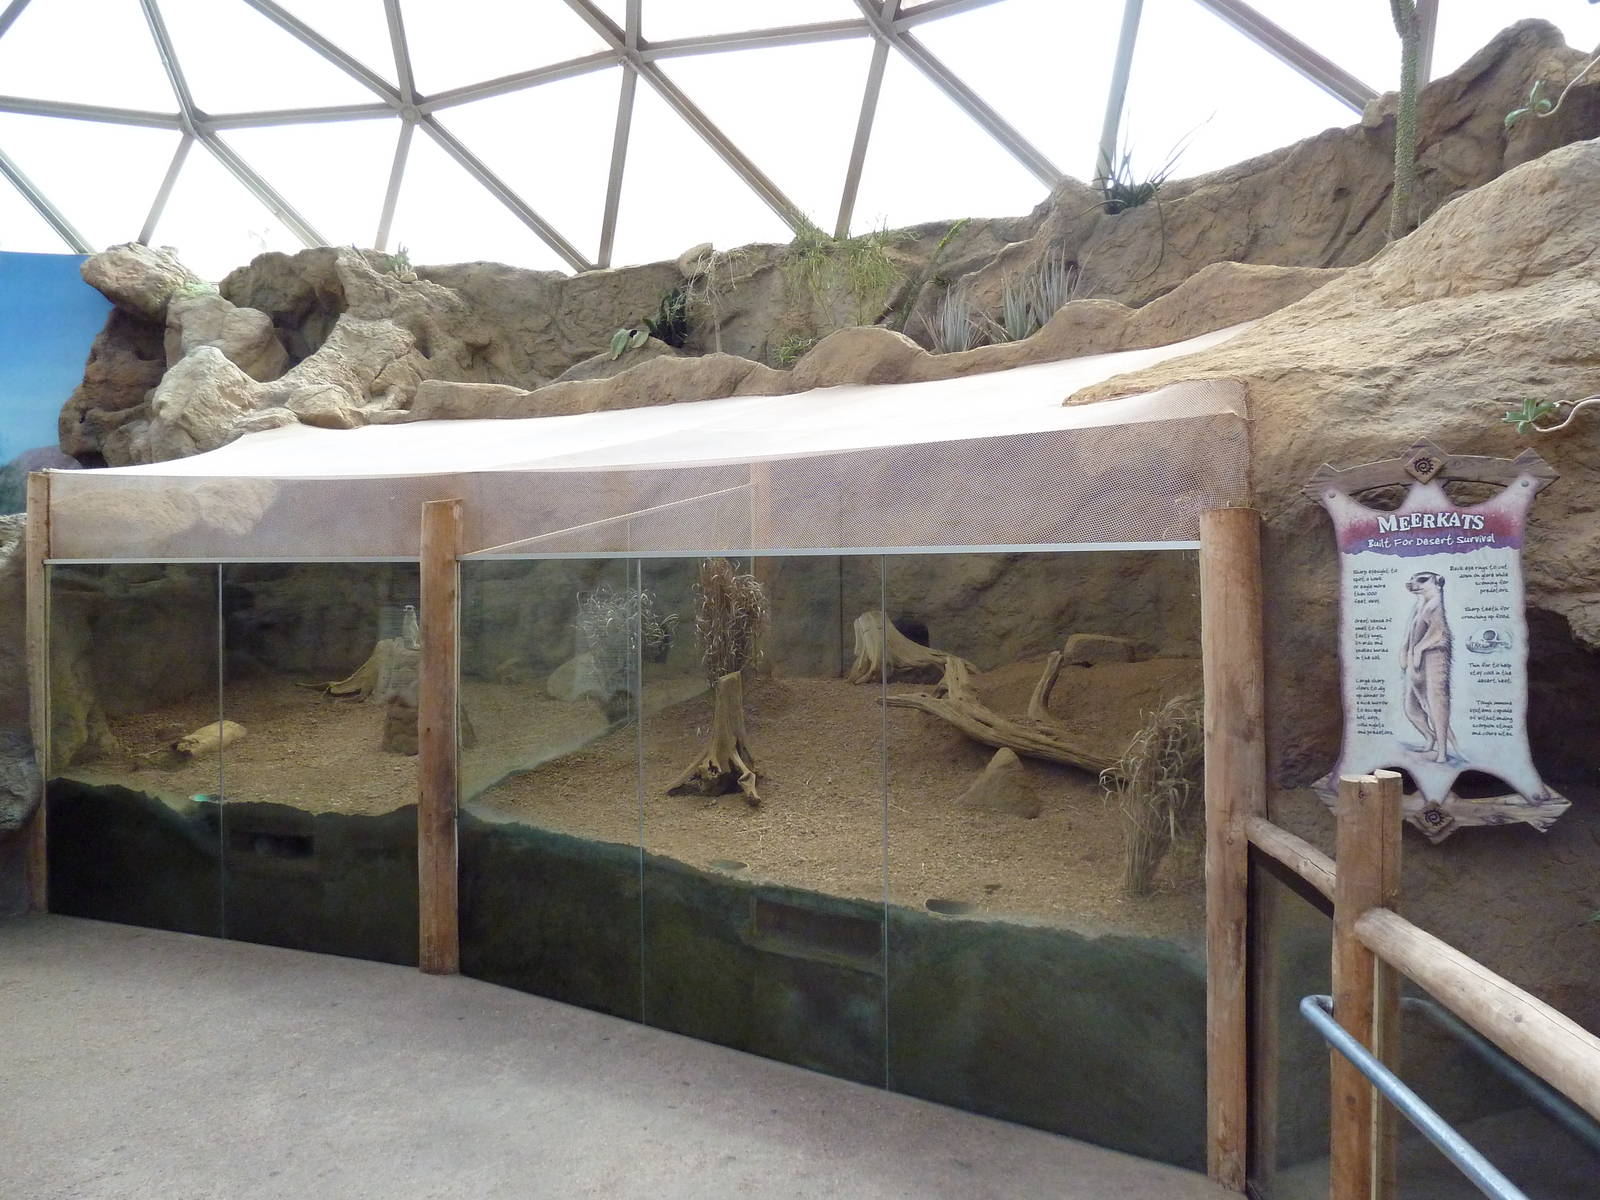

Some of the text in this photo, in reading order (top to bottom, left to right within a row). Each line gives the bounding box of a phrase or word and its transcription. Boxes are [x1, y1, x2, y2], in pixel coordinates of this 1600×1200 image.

[1377, 512, 1485, 533] MEERKATS
[1368, 537, 1392, 548] Built
[1416, 534, 1454, 546] Desert
[1456, 533, 1496, 544] Survival
